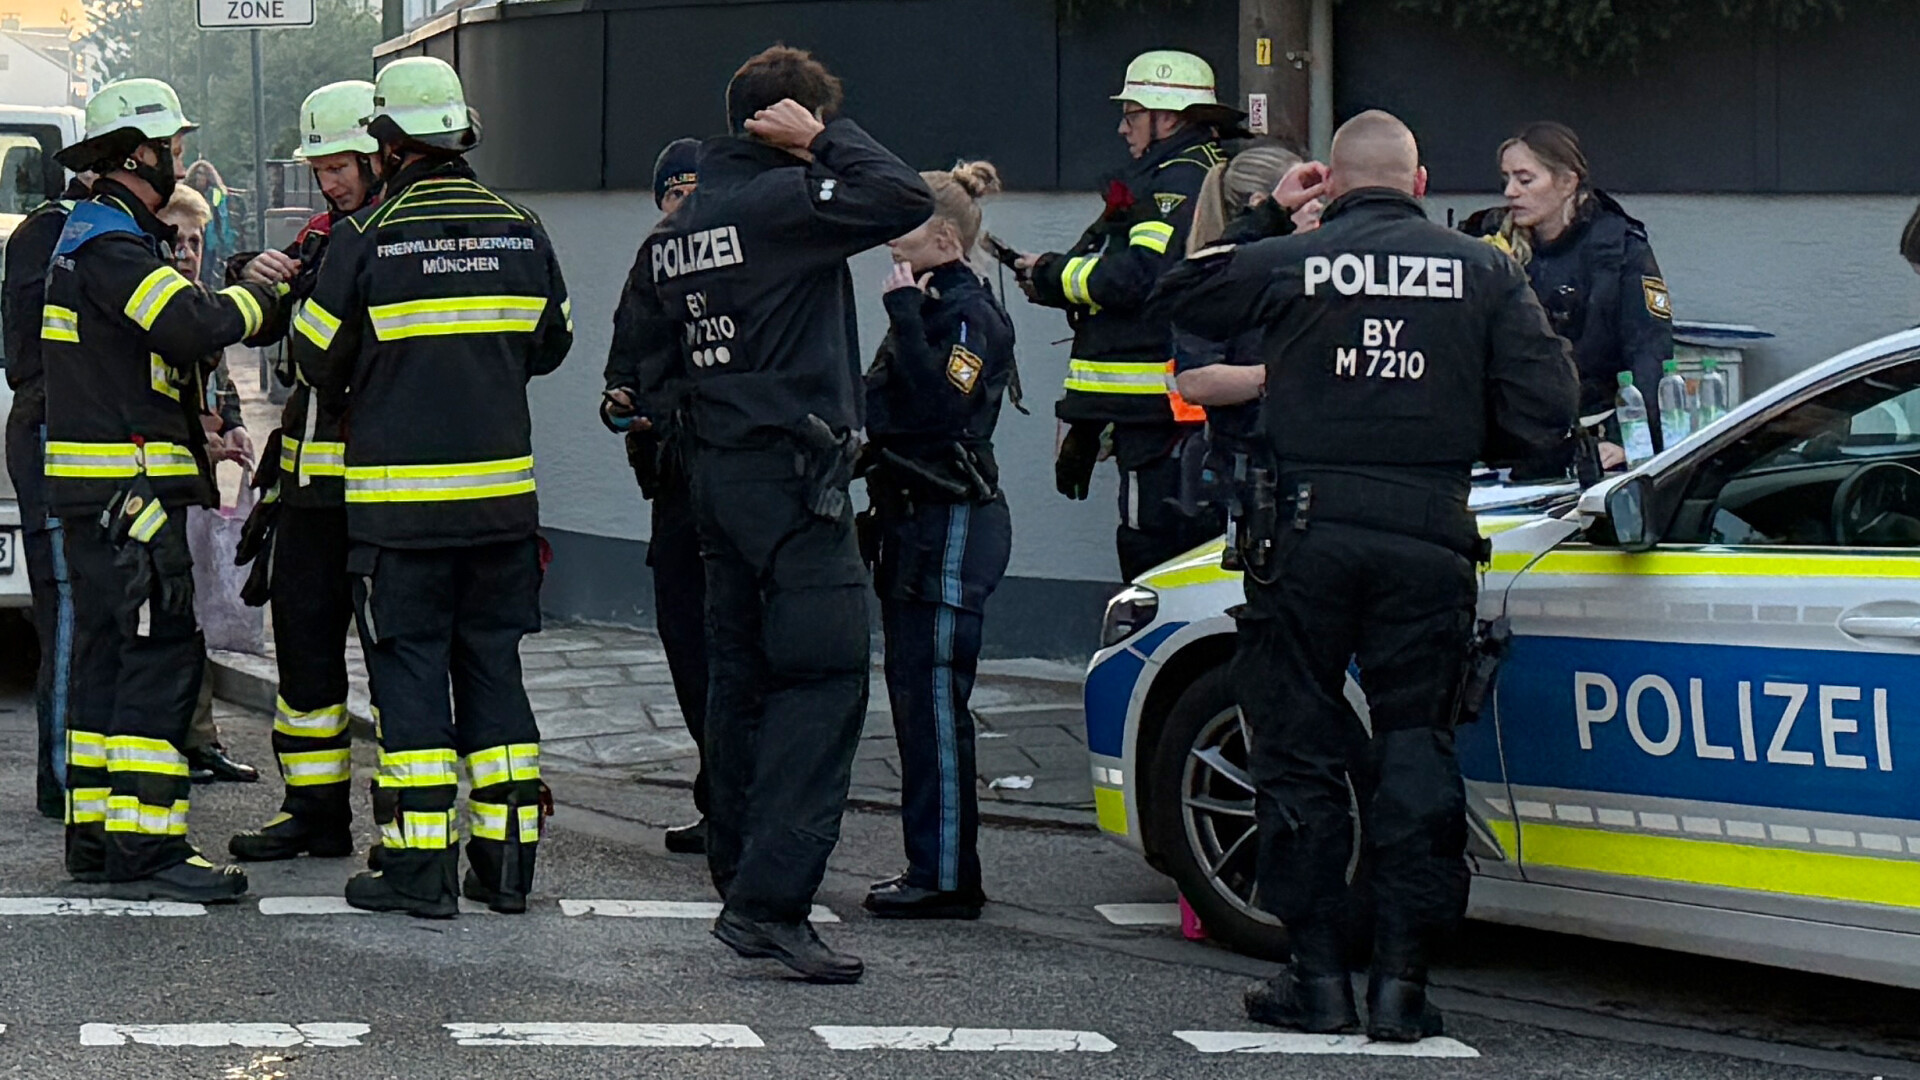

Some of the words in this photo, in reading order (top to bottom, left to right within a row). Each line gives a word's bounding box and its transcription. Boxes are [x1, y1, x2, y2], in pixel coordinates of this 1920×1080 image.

[227, 1, 284, 19] ZONE
[422, 255, 500, 275] MÜNCHEN
[651, 225, 744, 283] POLIZEI
[1304, 253, 1463, 299] POLIZEI
[686, 291, 707, 318] BY
[1363, 318, 1405, 348] BY
[1335, 347, 1358, 377] M
[1365, 349, 1425, 380] 7210
[1574, 671, 1894, 772] POLIZEI
